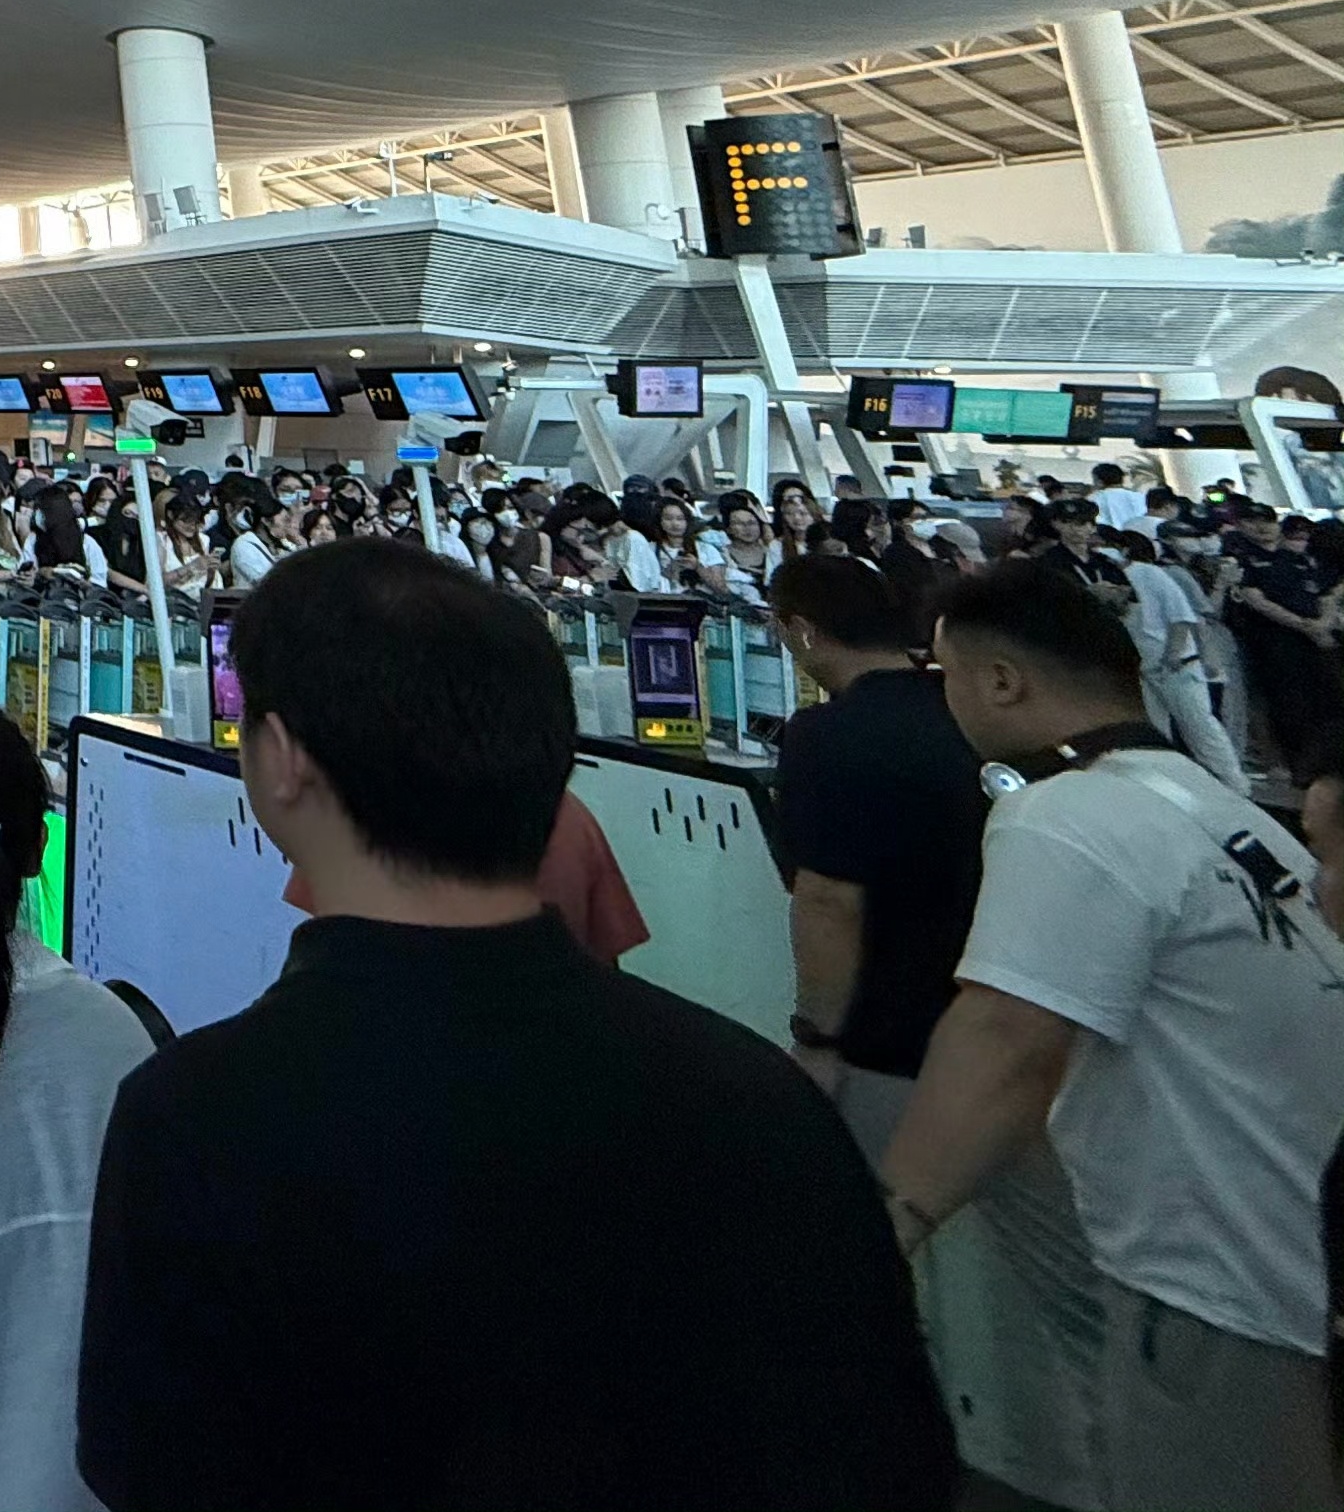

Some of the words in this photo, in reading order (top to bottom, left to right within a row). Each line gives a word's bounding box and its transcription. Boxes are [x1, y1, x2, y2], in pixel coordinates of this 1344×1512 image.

[725, 140, 809, 227] F
[45, 388, 63, 400] F20
[144, 386, 163, 400] F19
[238, 385, 262, 400] F18
[367, 387, 393, 403] F17
[863, 397, 888, 412] F16
[1074, 404, 1098, 419] F15
